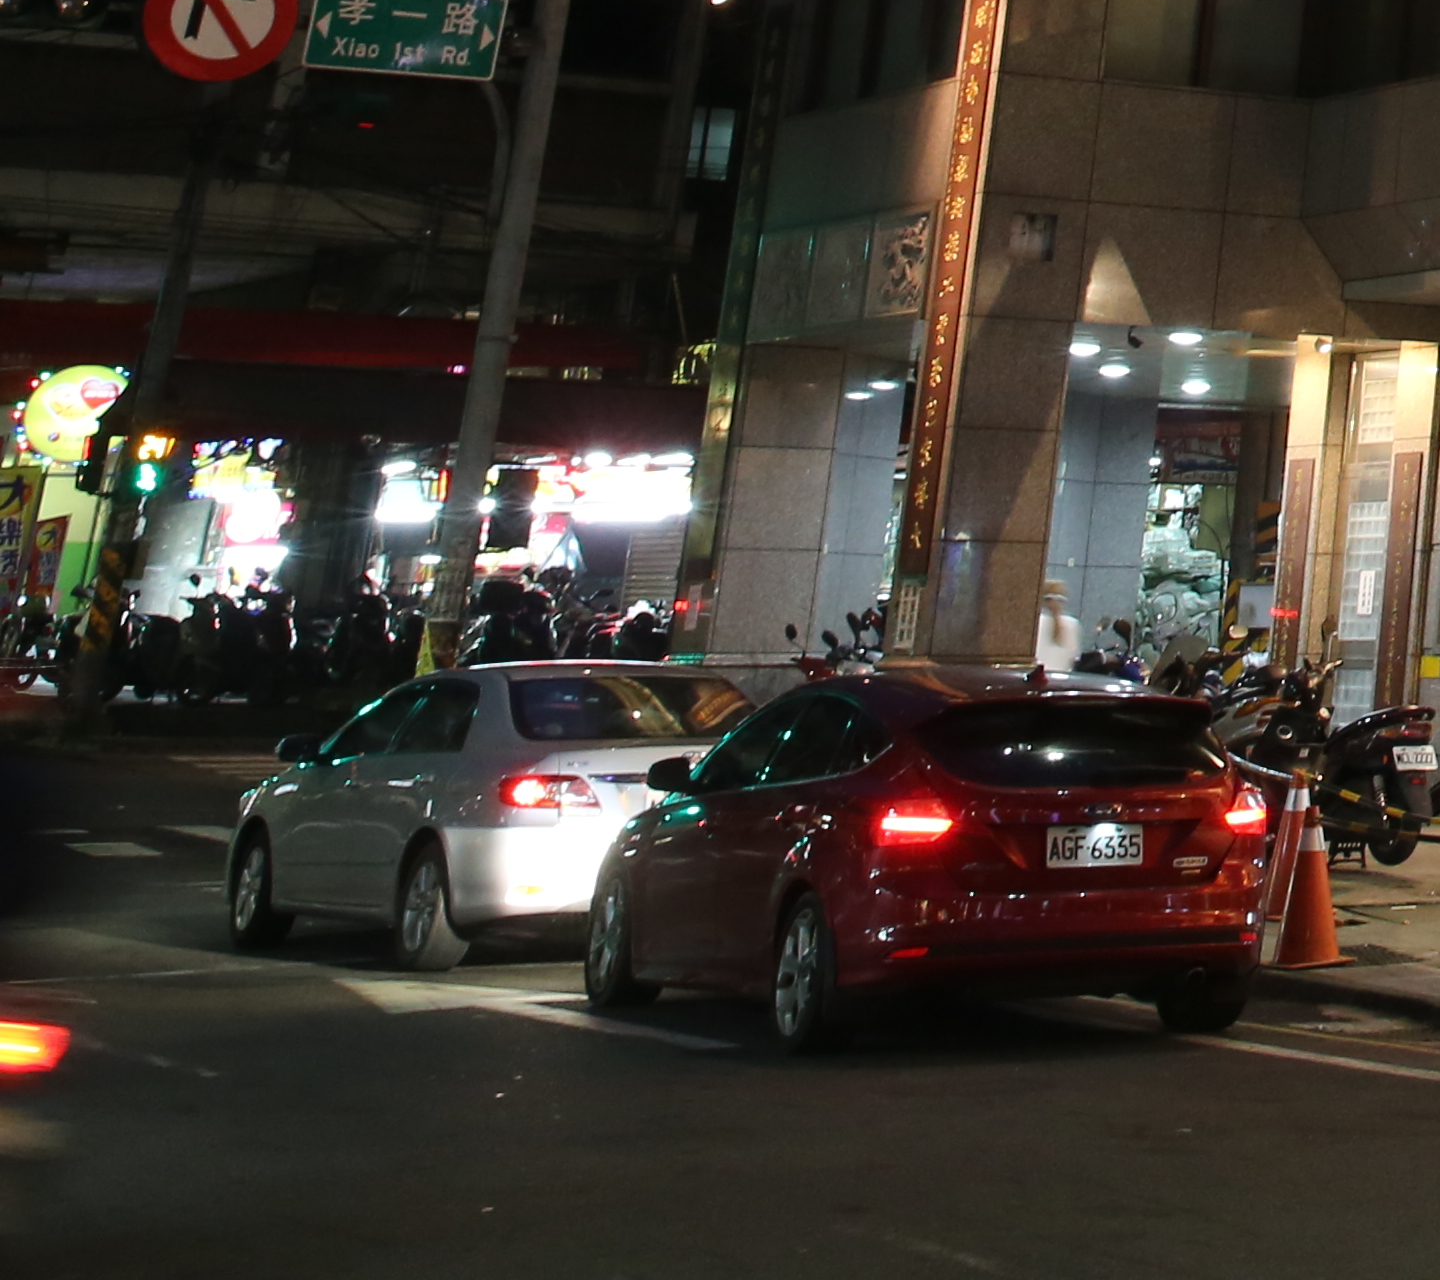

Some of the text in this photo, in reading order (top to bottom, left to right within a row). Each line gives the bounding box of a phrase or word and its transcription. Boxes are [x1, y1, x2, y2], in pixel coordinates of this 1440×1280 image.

[331, 36, 471, 66] Xiao 1st Rd.
